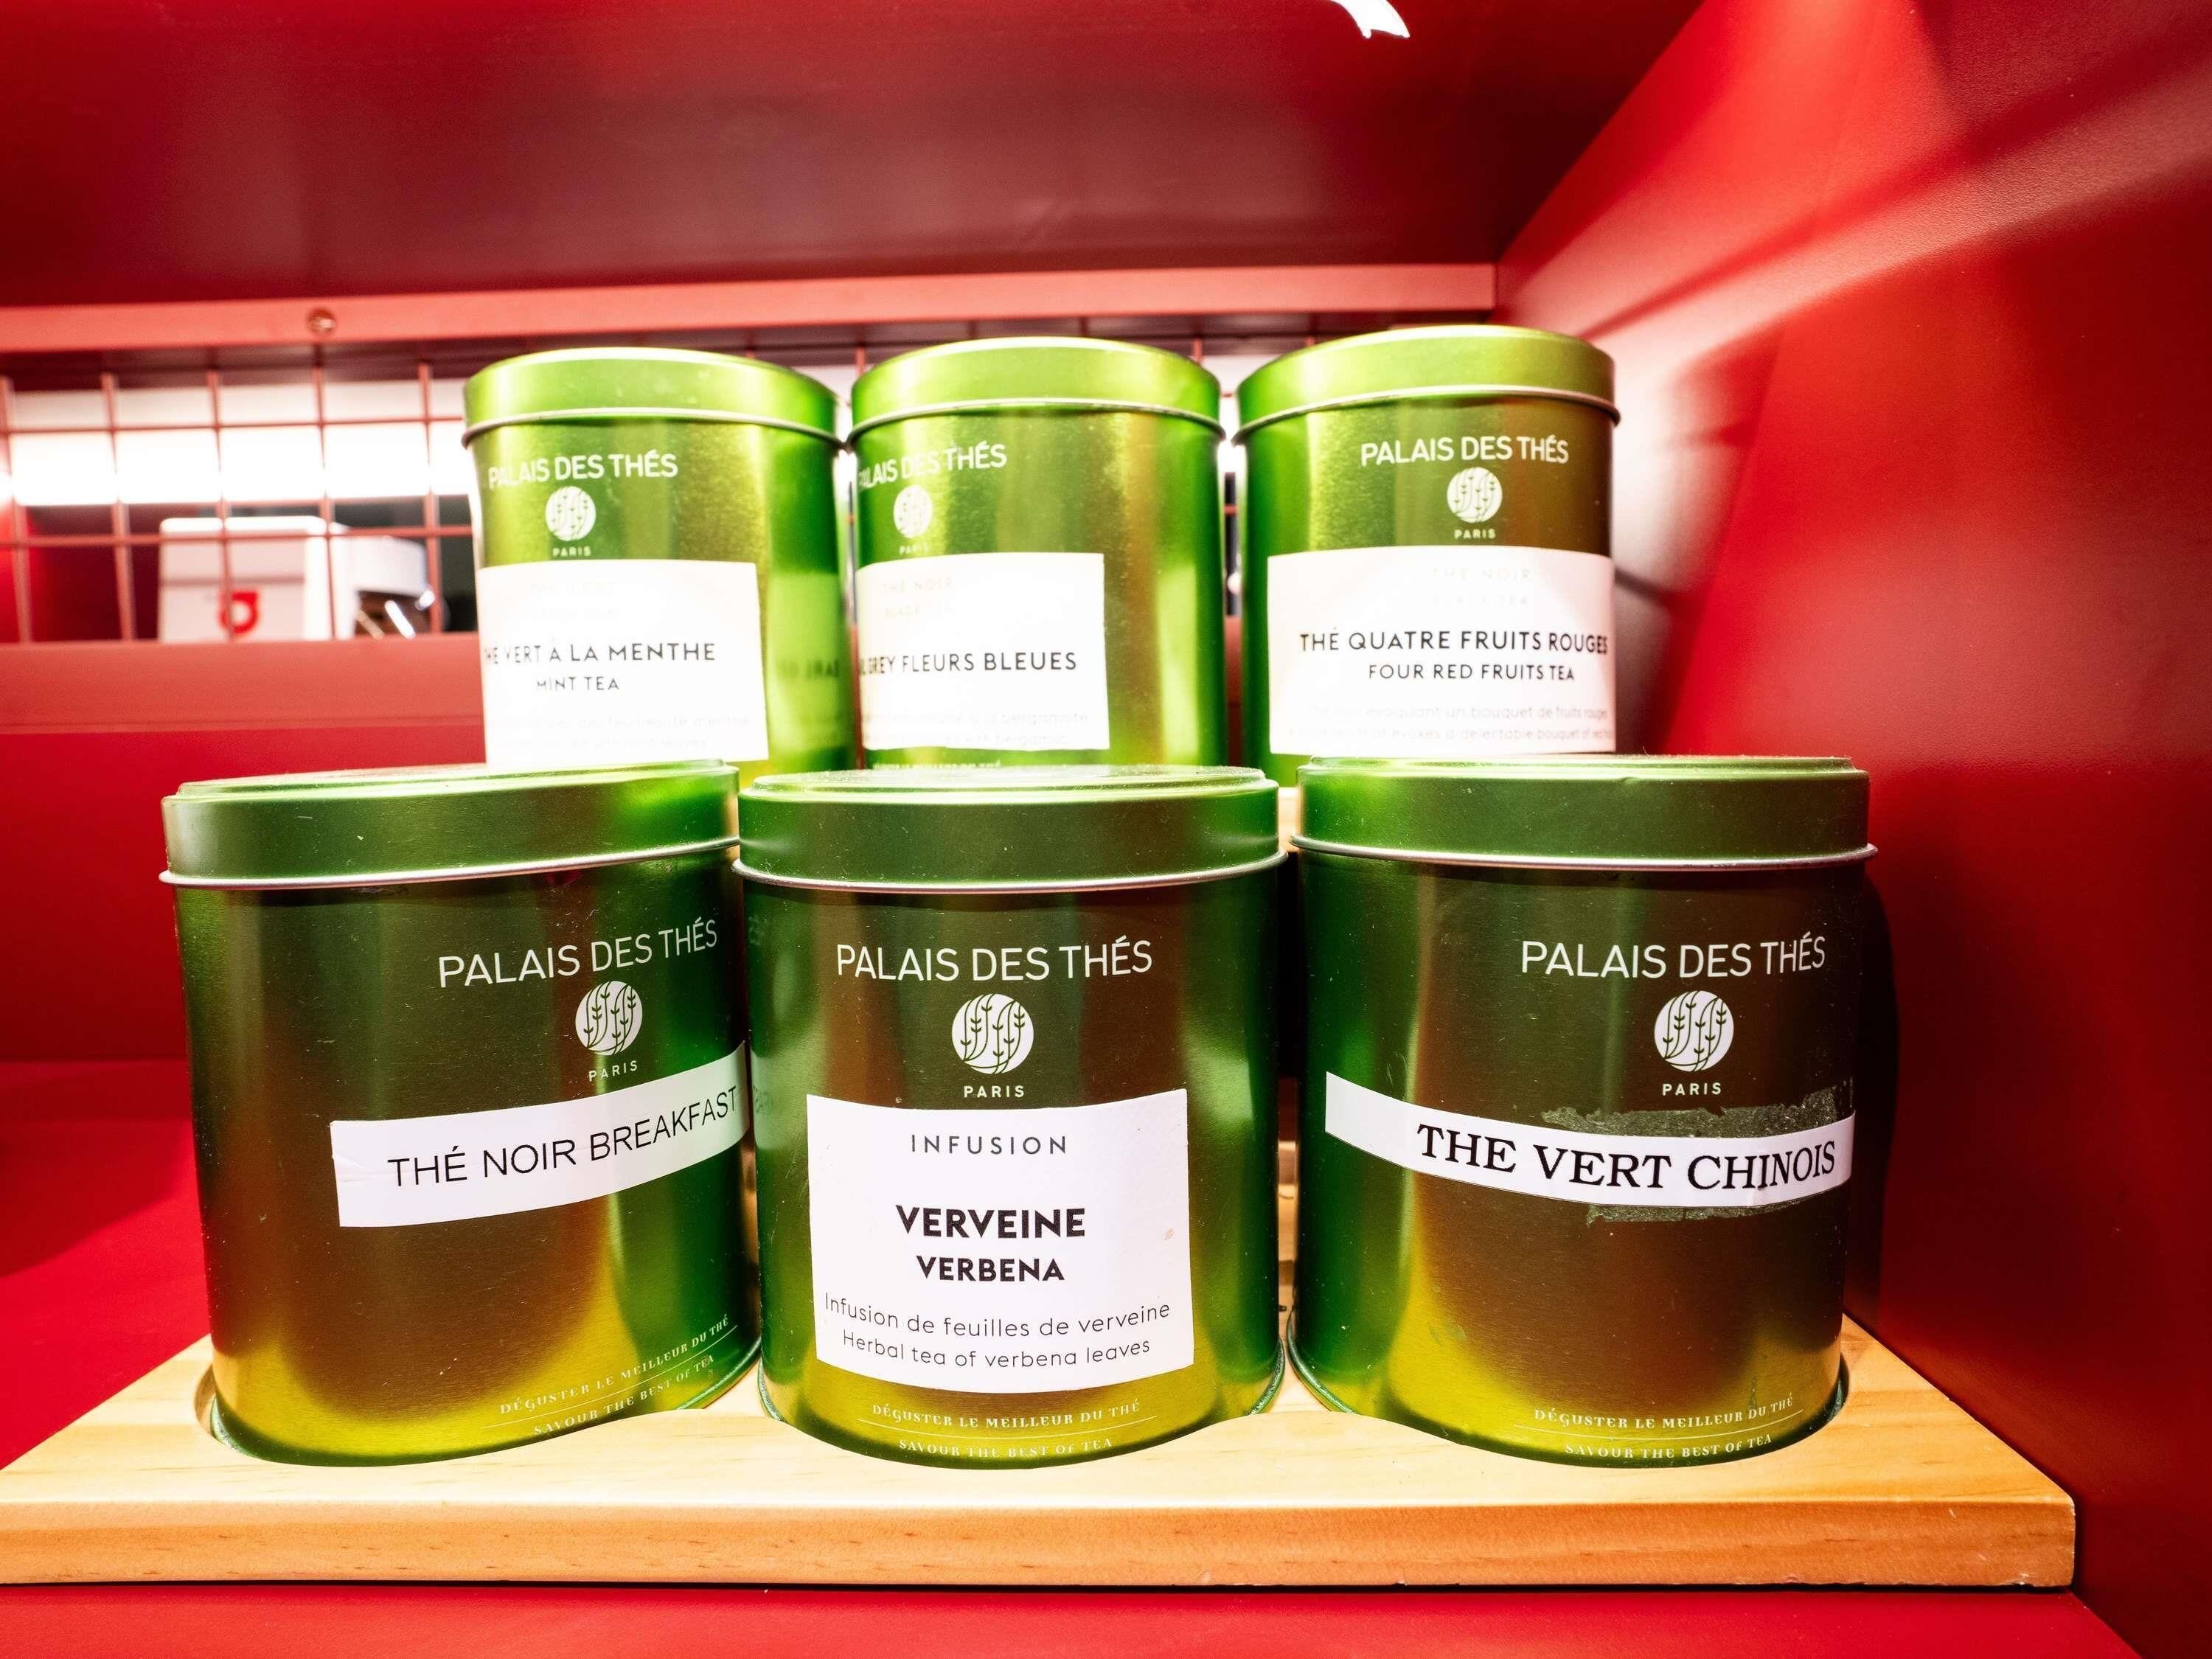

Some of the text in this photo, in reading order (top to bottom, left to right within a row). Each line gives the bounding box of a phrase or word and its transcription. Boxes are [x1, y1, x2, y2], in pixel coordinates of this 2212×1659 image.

[901, 450, 941, 479] DES
[944, 440, 1007, 471] THÉS
[1360, 434, 1570, 467] PALAIS DES THÉS
[488, 448, 678, 490] PALAIS DES THÉS
[1454, 529, 1497, 540] PARIS
[552, 546, 591, 557] PARIS
[504, 644, 542, 663] VERT
[570, 643, 599, 662] LA
[609, 642, 715, 661] MENTHE
[1300, 627, 1609, 655] THÉ QUATRE FRUITS ROUGES
[902, 653, 975, 672] FLEURS
[984, 652, 1077, 672] BLEUES
[1368, 664, 1575, 681] FOUR RED FRUITS TEA
[537, 675, 620, 691] MINT TEA
[438, 943, 581, 989] PALAIS
[591, 933, 653, 973] DES
[658, 916, 718, 959] THÉS
[837, 935, 1152, 981] PALAIS DES THÉS
[1521, 931, 1826, 979] PALAIS DES THÉS
[588, 1060, 639, 1082] PARIS
[963, 1085, 1026, 1099] PARIS
[1662, 1082, 1722, 1096] PARIS
[388, 1145, 468, 1188] THÉ
[484, 1138, 577, 1178] NOIR
[589, 1085, 738, 1162] BREAKFAST
[911, 1133, 1067, 1155] INFUSION
[1416, 1123, 1837, 1191] THE VERT CHINOIS
[895, 1204, 1086, 1239] VERVEINE
[916, 1255, 1065, 1282] VERBENA
[824, 1292, 1171, 1338] Infusion de feuilles de verveine
[499, 1313, 729, 1415] DÉGUSTER LE MEILLEUR DU THÉ
[842, 1329, 1151, 1368] Herbal tea of verbena leaves
[532, 1354, 715, 1436] SAVOUR THE BEST OF TEA
[1533, 1391, 1795, 1429] DÉGUSTER LE MEILLEUR DU THÉ
[872, 1397, 1141, 1429] DÉGUSTER LE MEILLEUR DU THÉ
[899, 1436, 1113, 1458] SAVOUR THE BEST OF TEA
[1565, 1433, 1773, 1459] SAVOUR THE BEST OF TEA
